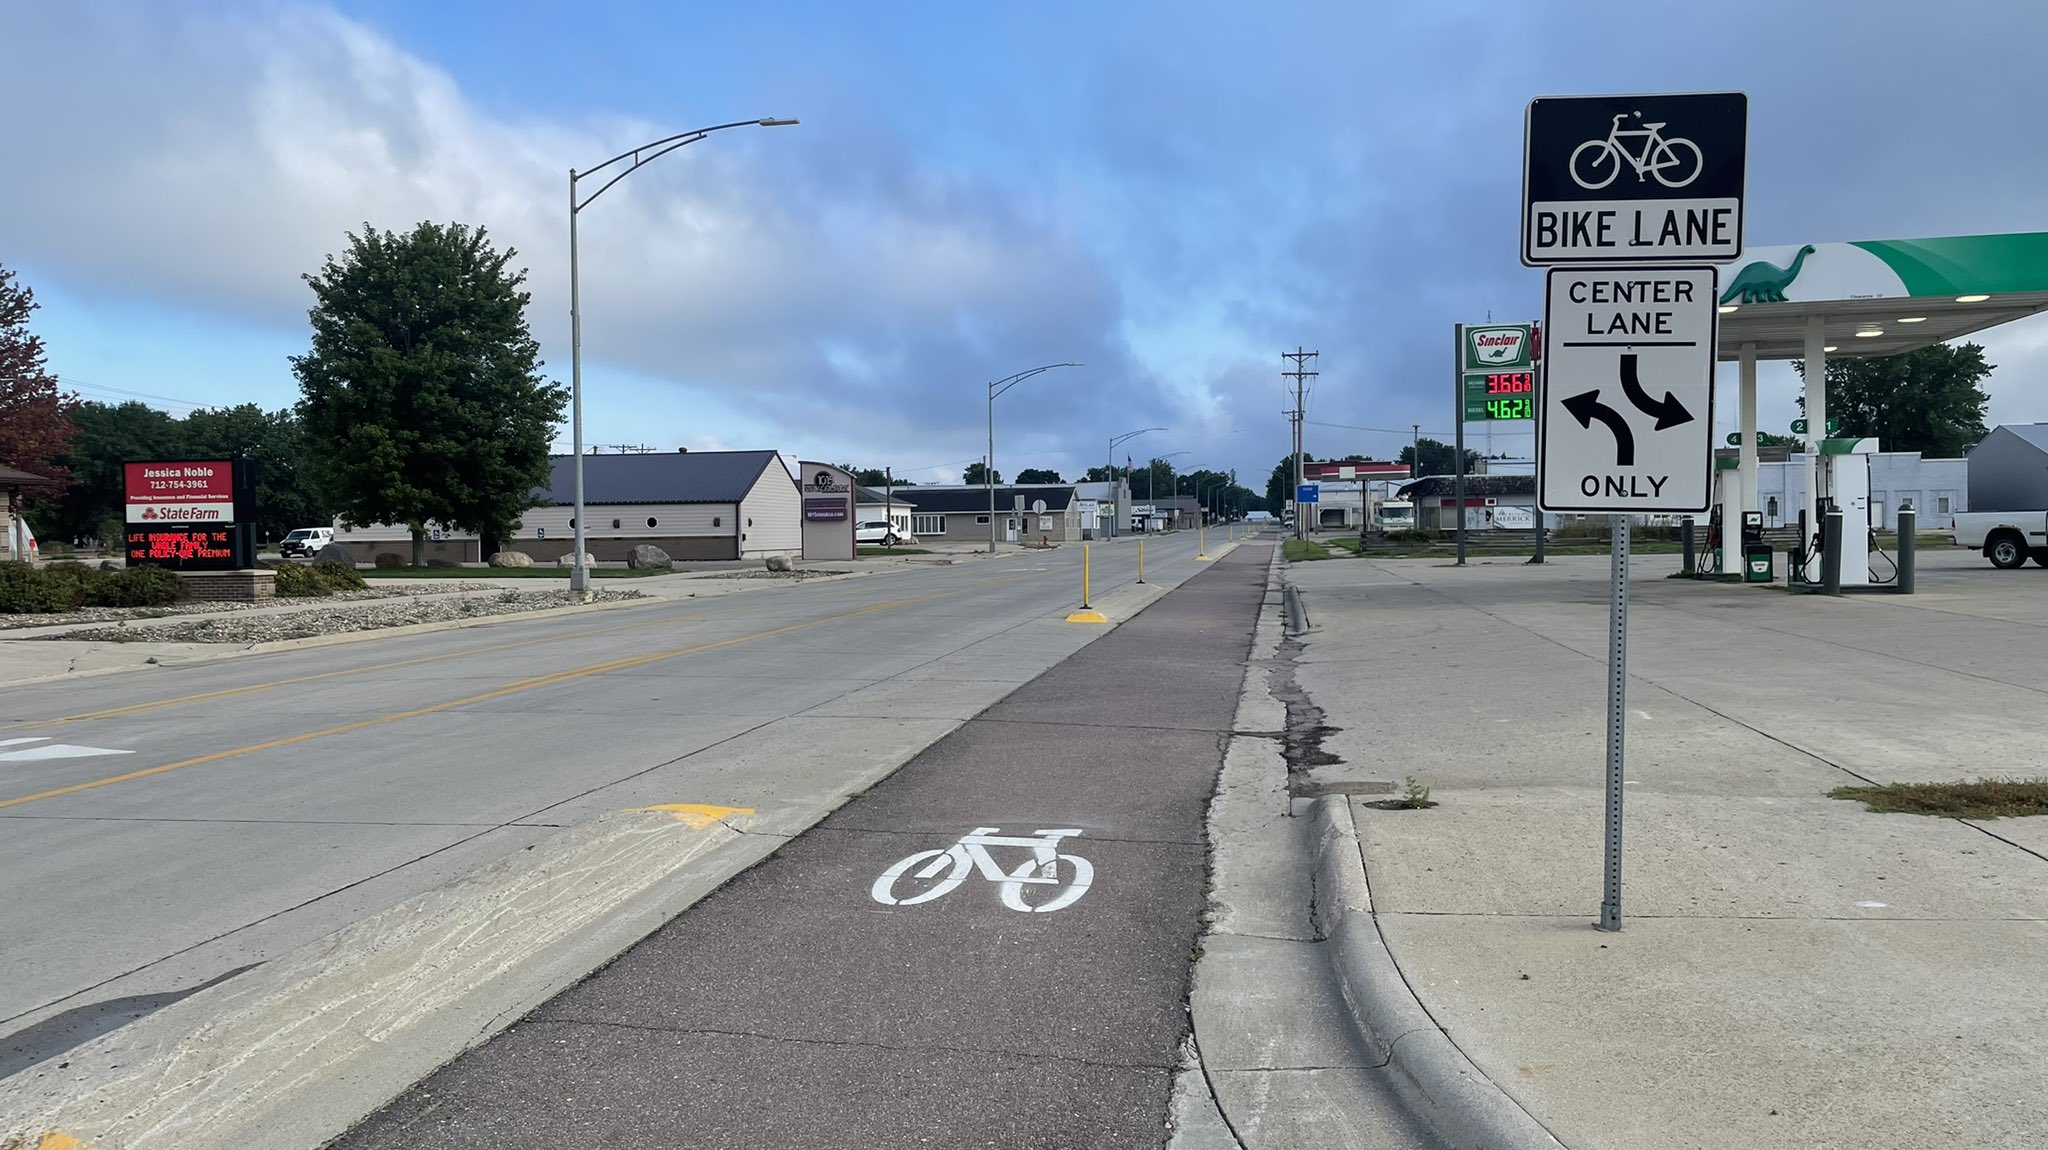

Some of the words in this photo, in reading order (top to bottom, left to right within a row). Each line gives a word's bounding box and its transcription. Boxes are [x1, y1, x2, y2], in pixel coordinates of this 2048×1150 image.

[1536, 210, 1616, 248] BIKE
[1629, 208, 1732, 247] LANE
[1569, 280, 1694, 303] CENTER
[1587, 312, 1673, 334] LANE
[1477, 334, 1520, 347] Sinclair
[1796, 421, 1804, 431] 2
[1826, 421, 1831, 430] 1
[1730, 435, 1737, 443] 4
[1757, 434, 1764, 442] 3
[144, 468, 181, 478] Jessica
[184, 467, 214, 477] Noble
[150, 480, 208, 489] 712-754-3961
[1580, 474, 1669, 498] ONLY
[128, 533, 145, 542] LIFE
[148, 533, 188, 542] INSURANCE
[192, 533, 207, 542] FOR
[211, 532, 227, 541] THE
[151, 541, 176, 549] WHOLE
[180, 541, 208, 549] FAMILY
[131, 549, 145, 558] ONE
[198, 549, 231, 558] PREMIUM
